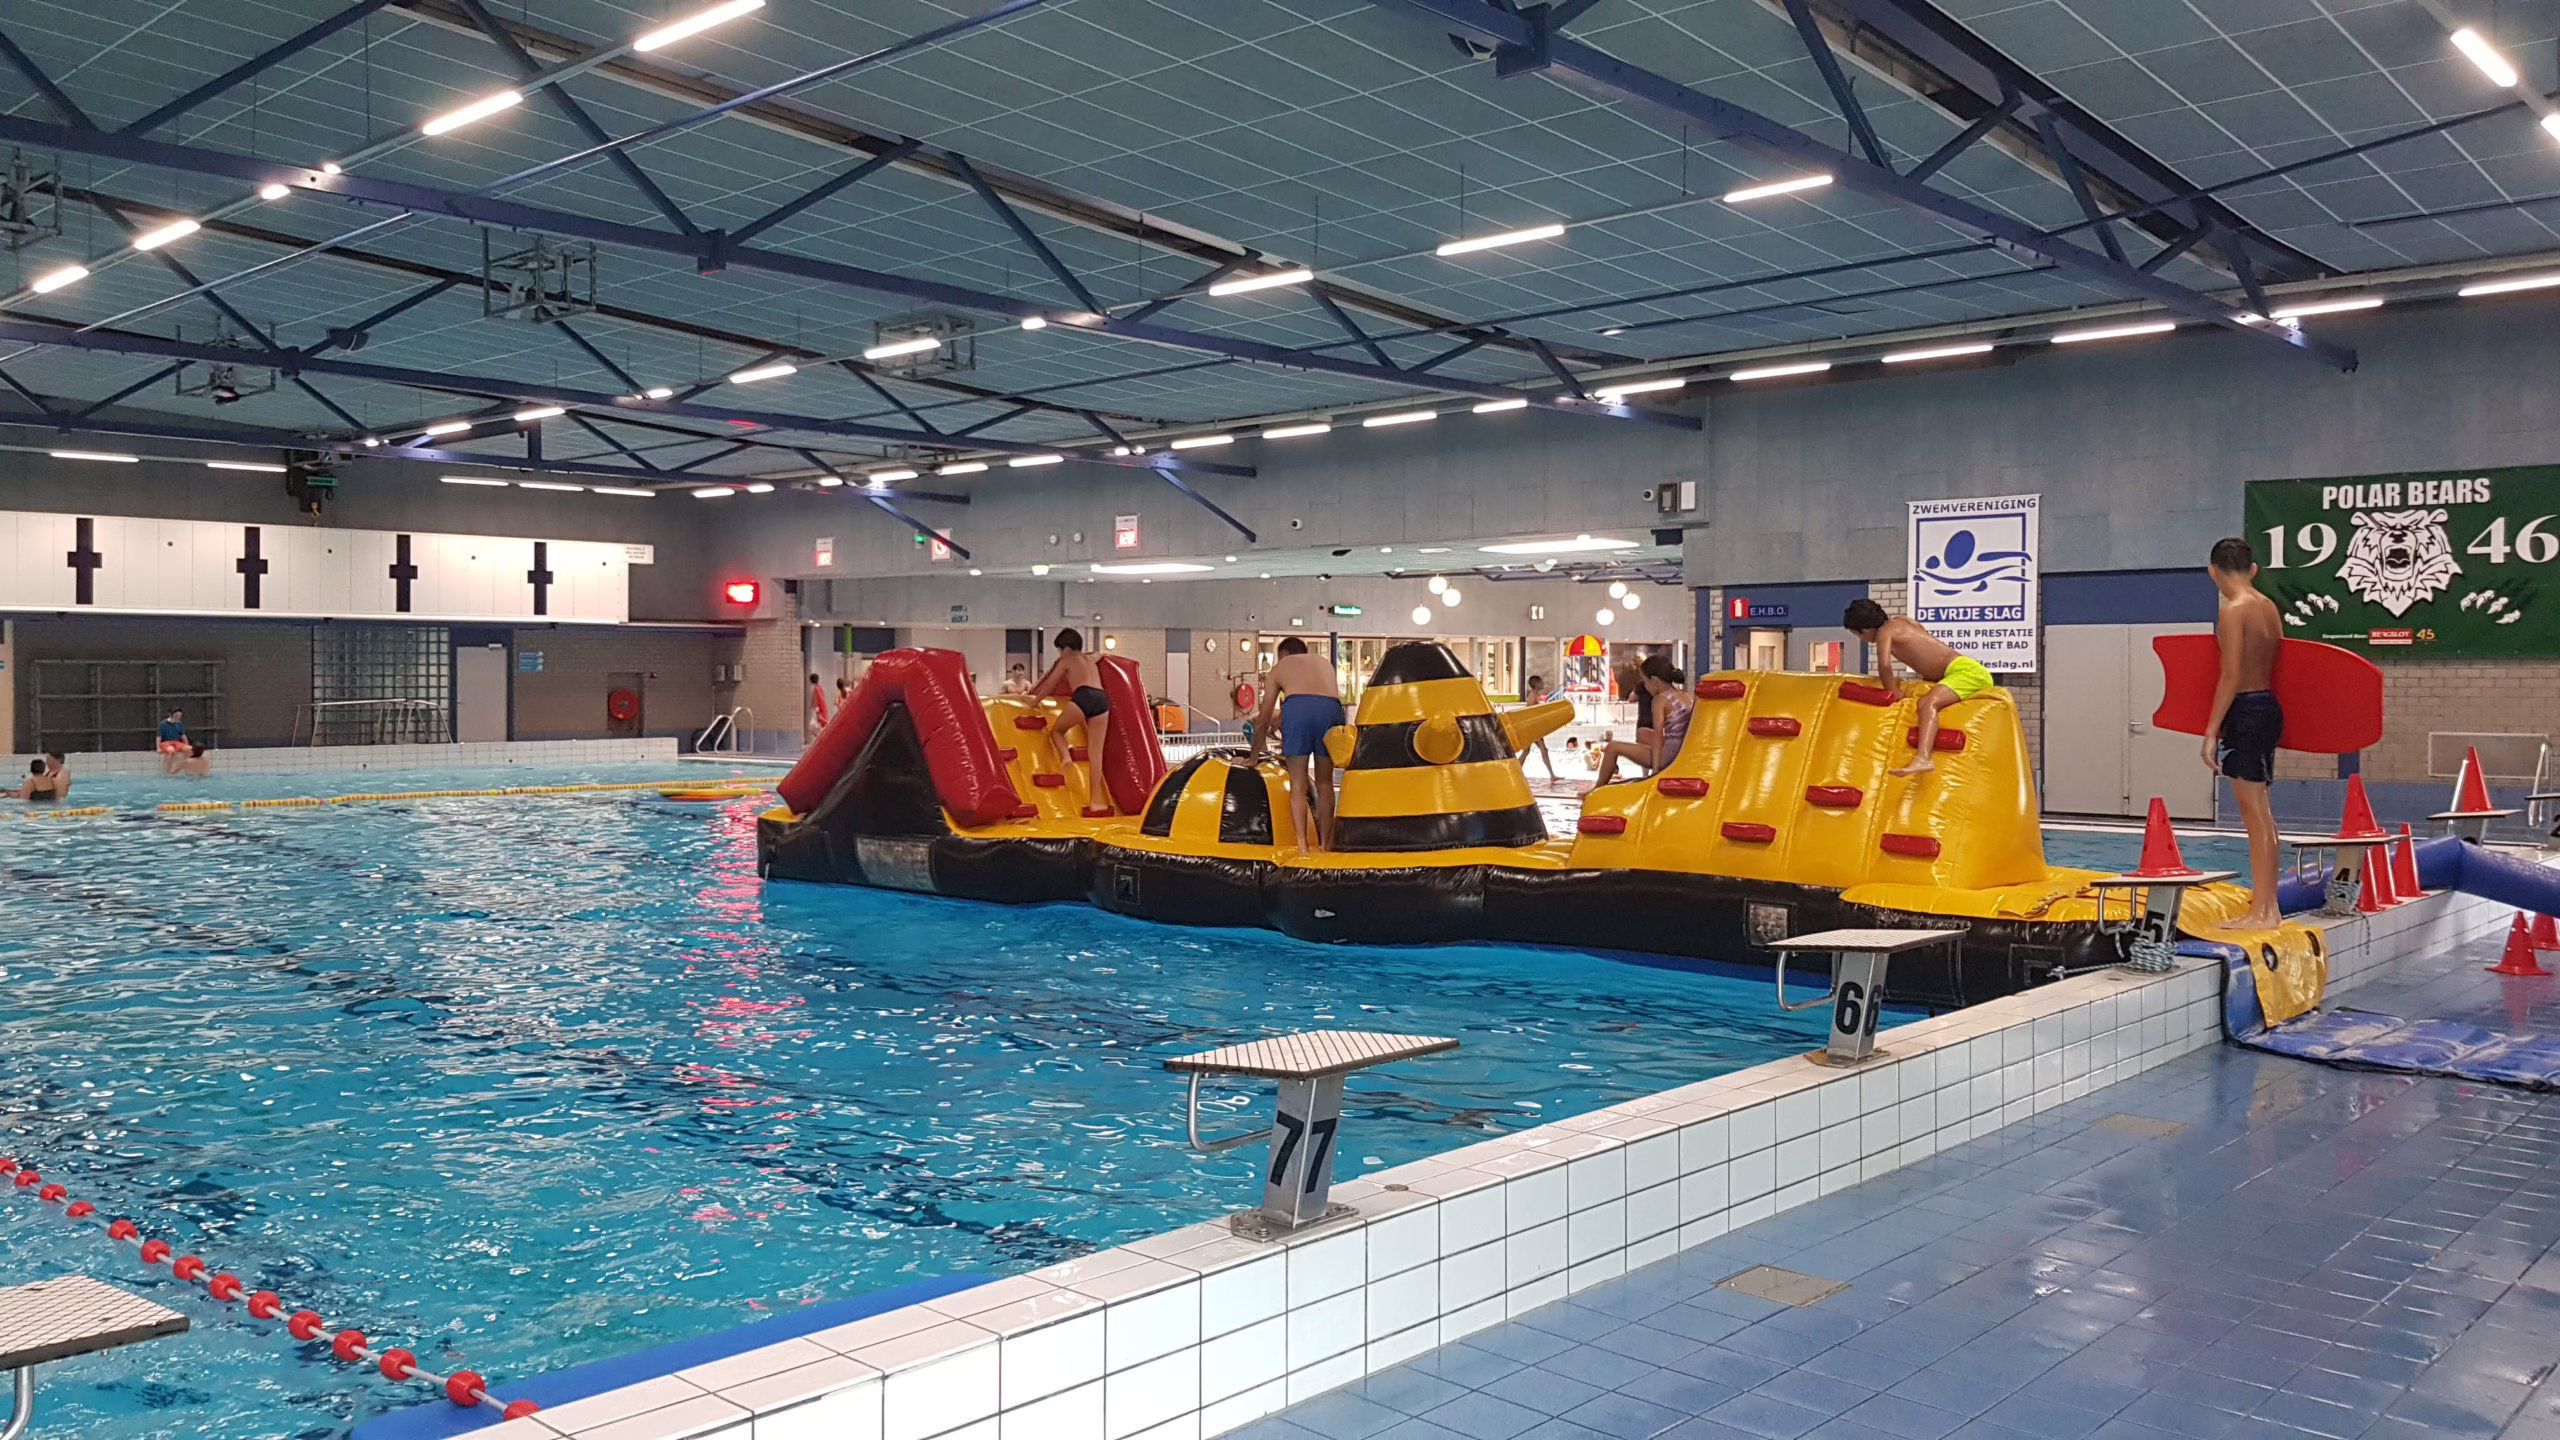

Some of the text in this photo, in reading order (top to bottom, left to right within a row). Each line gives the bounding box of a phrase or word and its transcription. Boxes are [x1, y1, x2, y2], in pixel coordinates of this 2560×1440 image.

[1912, 498, 2037, 515] ZWEMVERENIGING
[2322, 477, 2491, 510] POLAR BEARS
[2262, 522, 2338, 569] 19
[1750, 606, 1787, 616] E.H.B.O.
[1917, 606, 2022, 621] DE VRIJE SLAG
[1948, 641, 2029, 650] ROND HET BAD
[1957, 629, 1971, 638] EN
[1974, 628, 2034, 638] PRESTATIE
[1835, 981, 1864, 1035] 6
[1864, 984, 1882, 1037] 6
[1270, 1110, 1304, 1187] 7
[1305, 1117, 1337, 1194] 7
